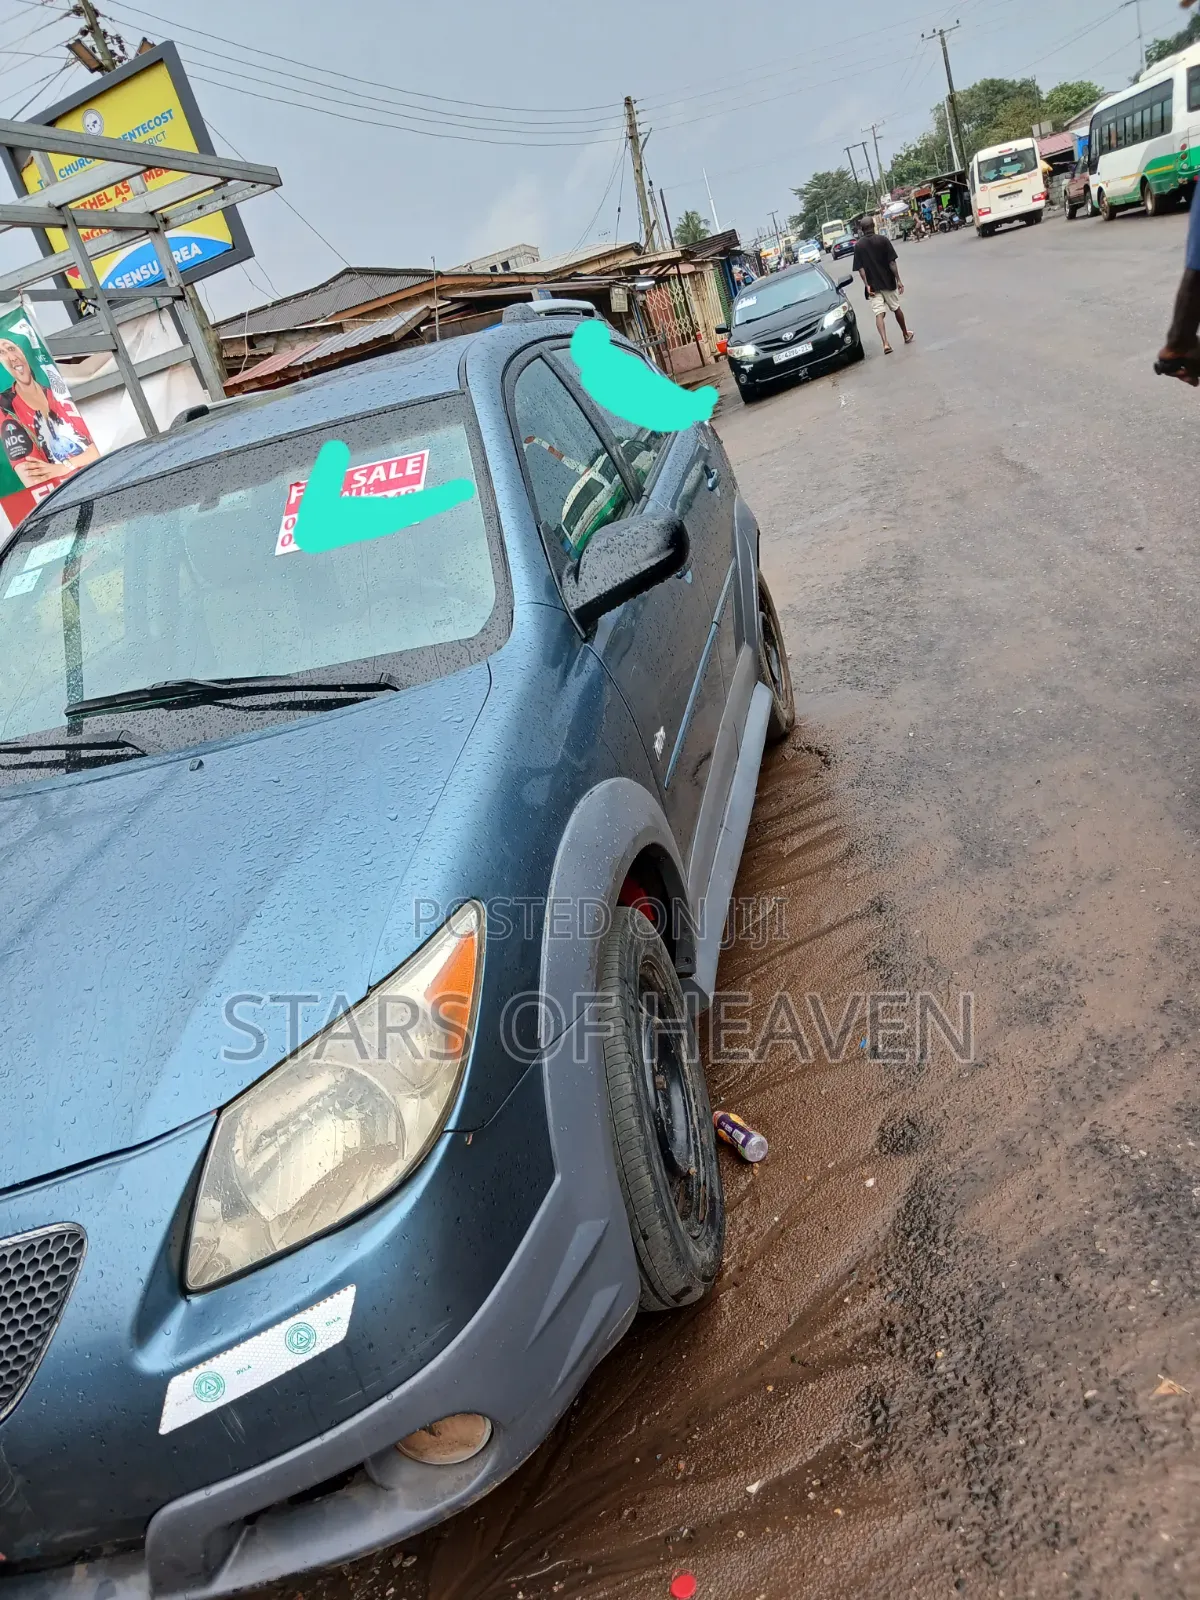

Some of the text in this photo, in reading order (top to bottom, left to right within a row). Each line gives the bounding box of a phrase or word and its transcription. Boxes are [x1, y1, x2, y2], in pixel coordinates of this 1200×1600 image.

[58, 109, 174, 178] CHURC ENTECOST
[75, 191, 113, 210] THEL
[172, 243, 202, 265] REA
[5, 434, 26, 449] NDC
[351, 456, 421, 489] SALE
